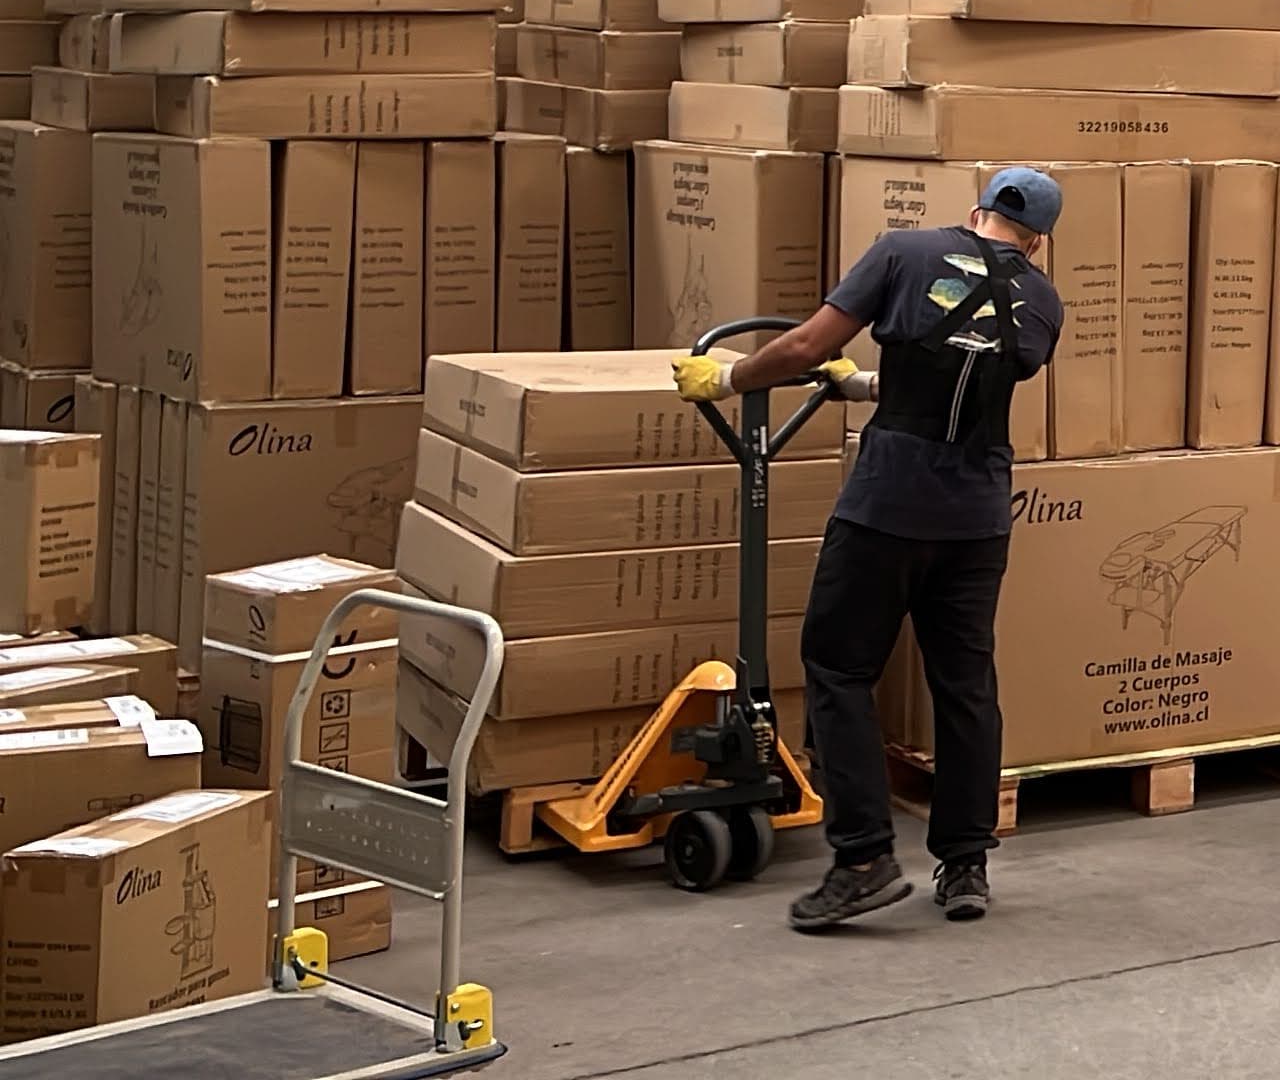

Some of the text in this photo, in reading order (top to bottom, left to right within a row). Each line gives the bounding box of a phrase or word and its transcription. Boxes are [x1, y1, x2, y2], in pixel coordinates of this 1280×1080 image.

[1078, 121, 1169, 133] 32219058436
[229, 423, 312, 456] Olina
[1084, 647, 1233, 678] Camilla de Masaje
[1118, 671, 1200, 694] 2 Cuerpos
[1103, 688, 1209, 716] Color: Negro
[1104, 706, 1210, 735] www.olina.cl
[117, 866, 161, 905] Olina
